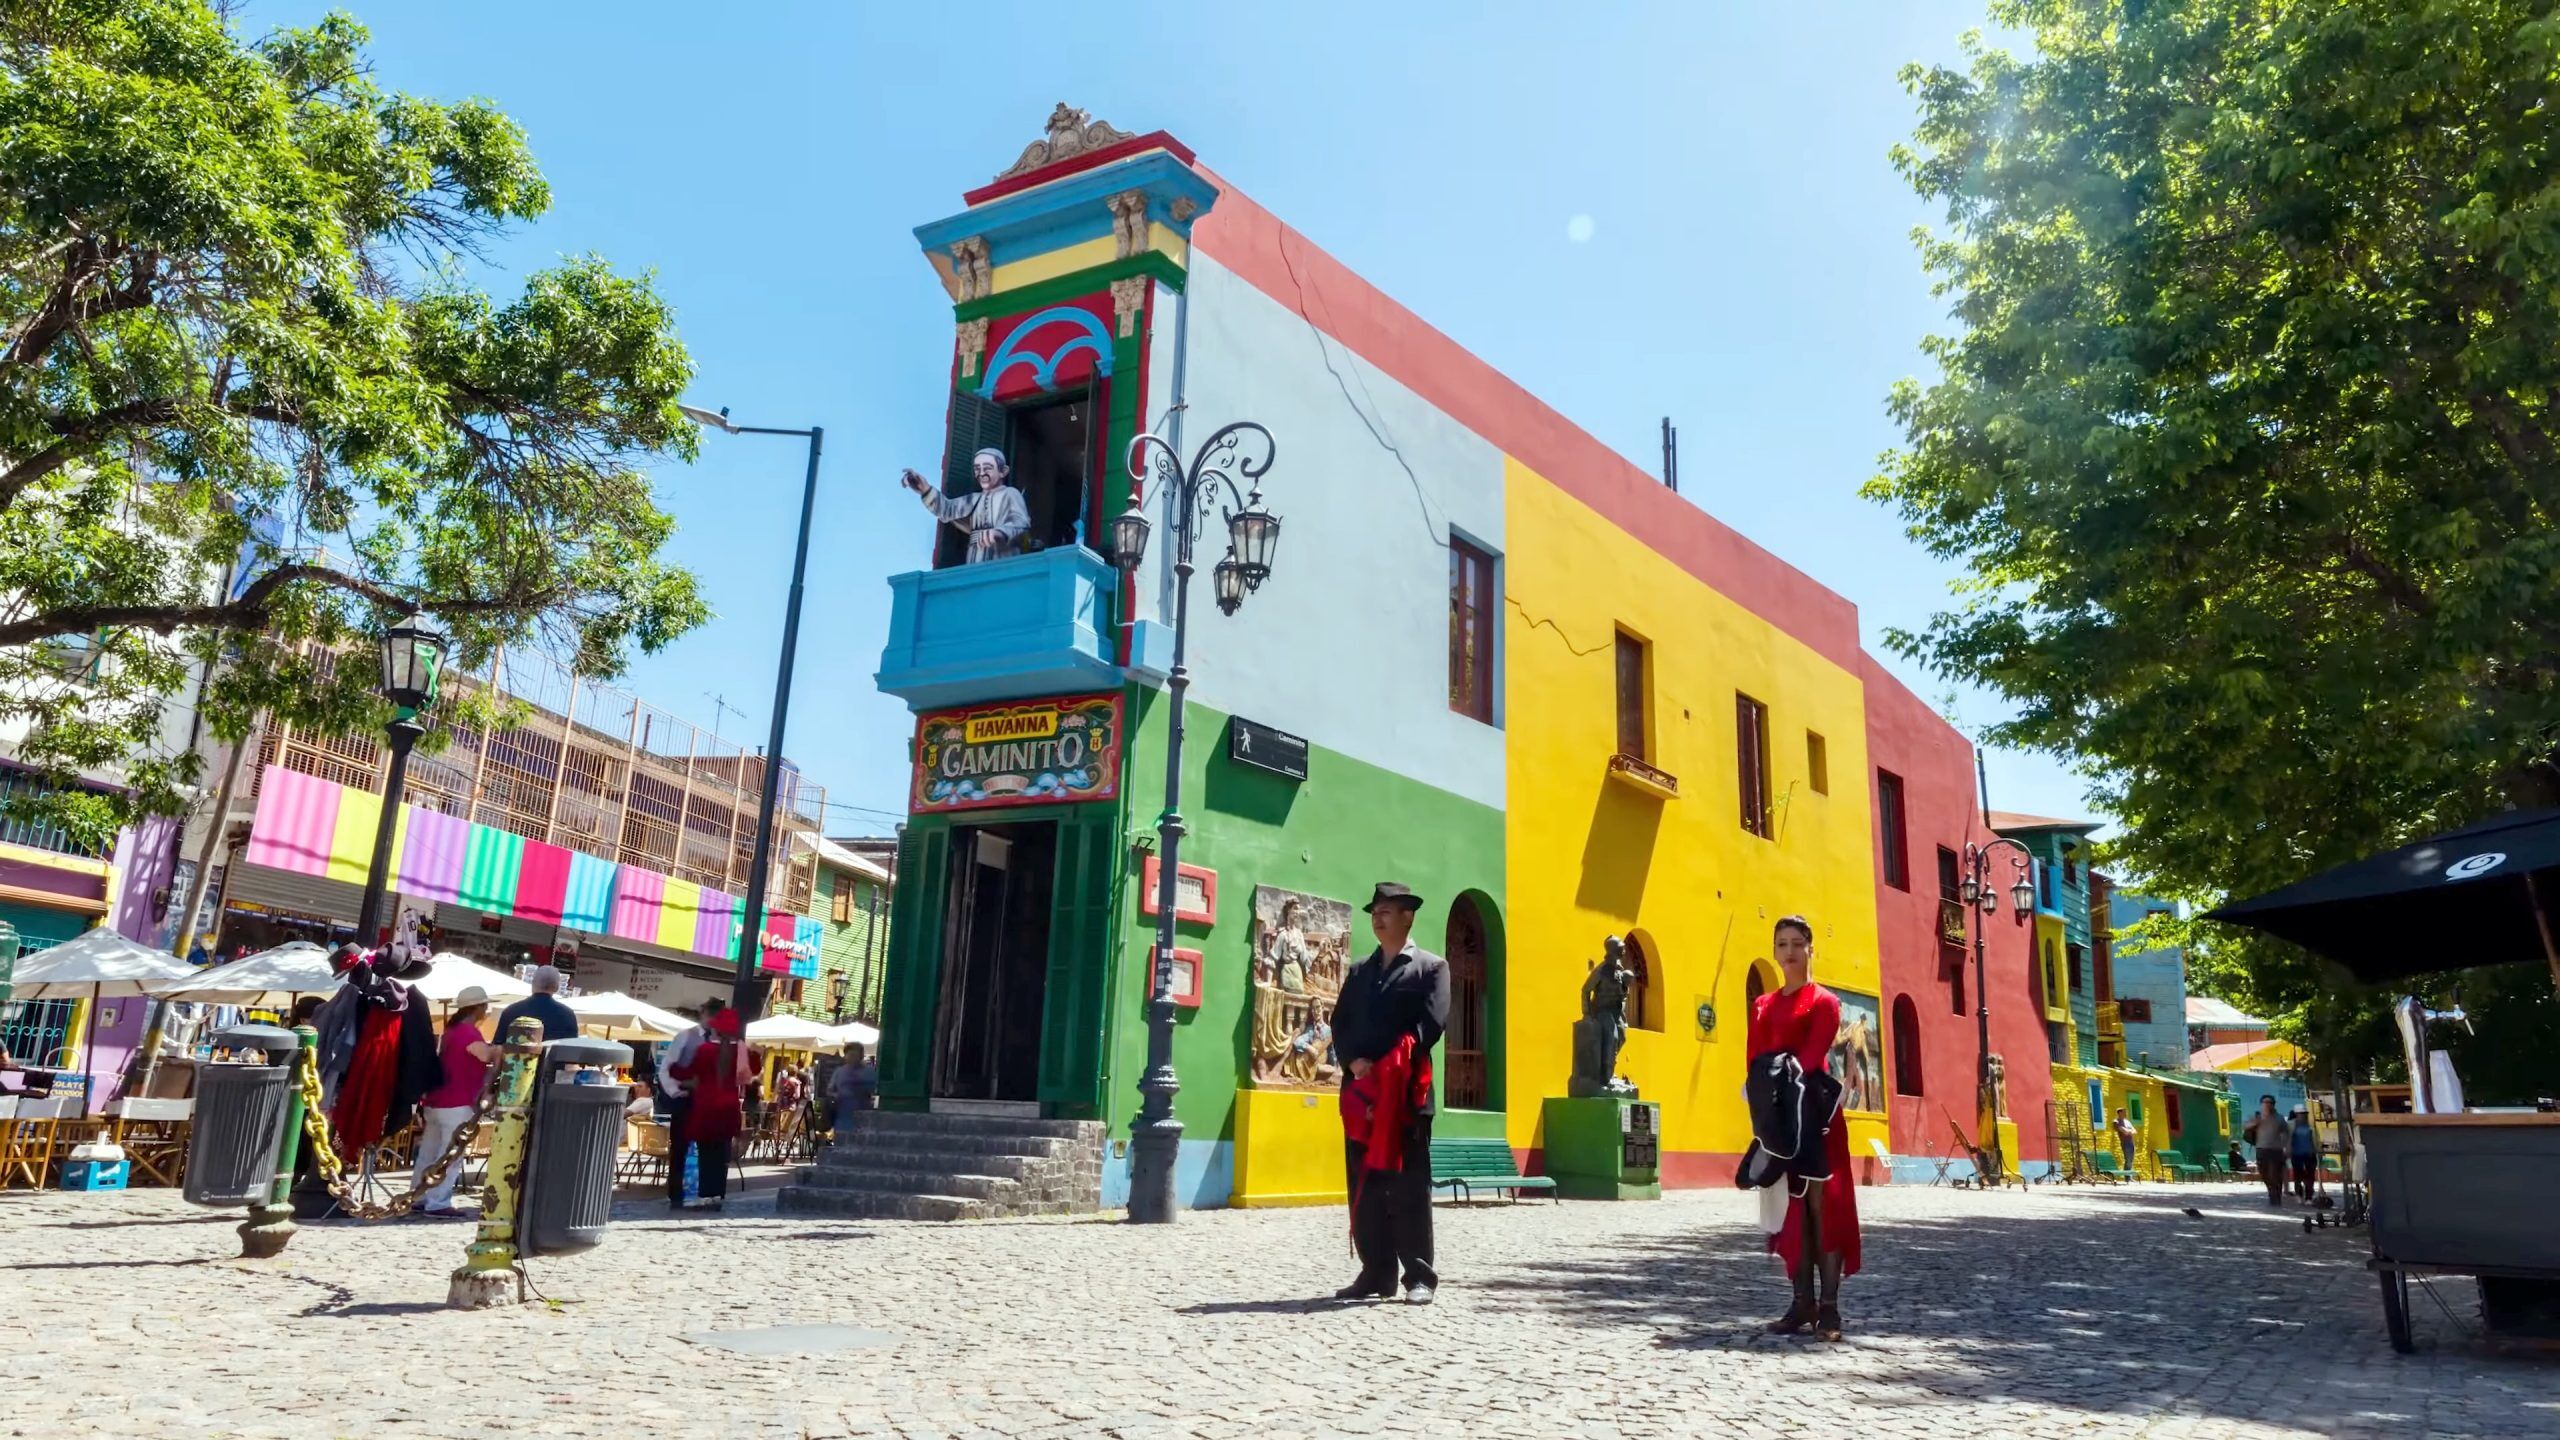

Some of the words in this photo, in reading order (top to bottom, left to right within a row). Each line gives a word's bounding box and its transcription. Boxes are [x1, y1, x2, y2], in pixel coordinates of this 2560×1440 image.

[974, 715, 1049, 738] HAVANNA
[1278, 732, 1306, 749] Caminito
[942, 732, 1084, 777] CAMINITO
[407, 920, 417, 932] 10
